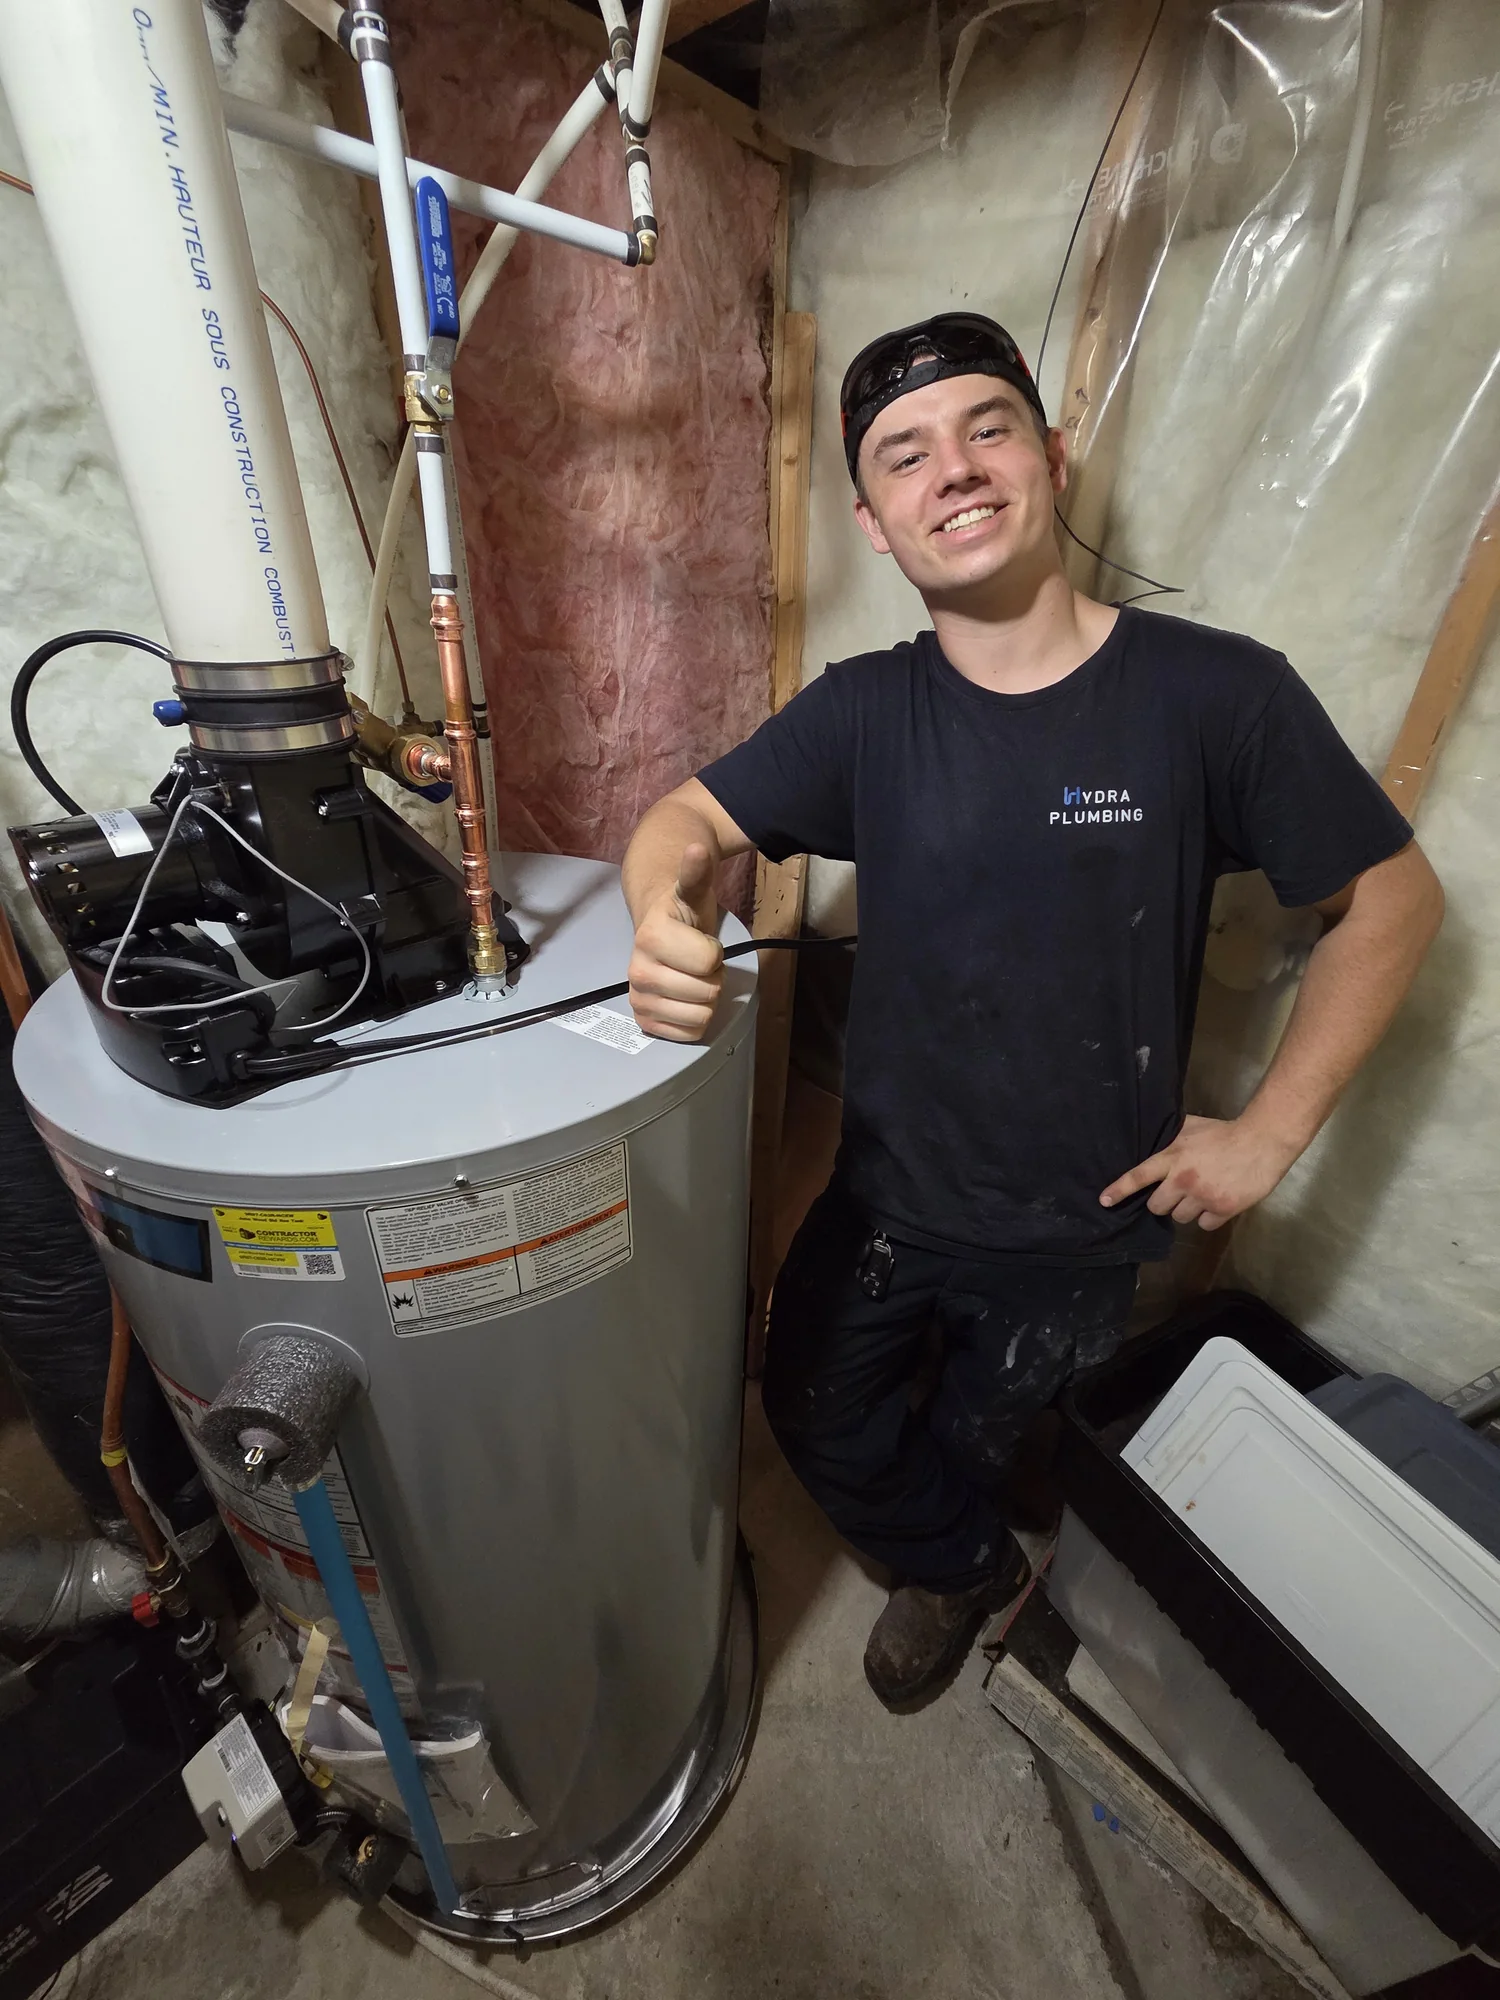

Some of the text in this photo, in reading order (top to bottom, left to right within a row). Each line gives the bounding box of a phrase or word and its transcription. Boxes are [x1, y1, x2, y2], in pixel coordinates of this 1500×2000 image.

[168, 164, 212, 291] HAUTEUR
[202, 308, 231, 371] SOUS
[220, 386, 273, 554] CONSTRUCTION
[1064, 786, 1130, 805] HYDRA
[1049, 808, 1143, 825] PLUMBING
[548, 1210, 613, 1242] AVERTISSEMENT
[433, 1259, 479, 1273] WARNING
